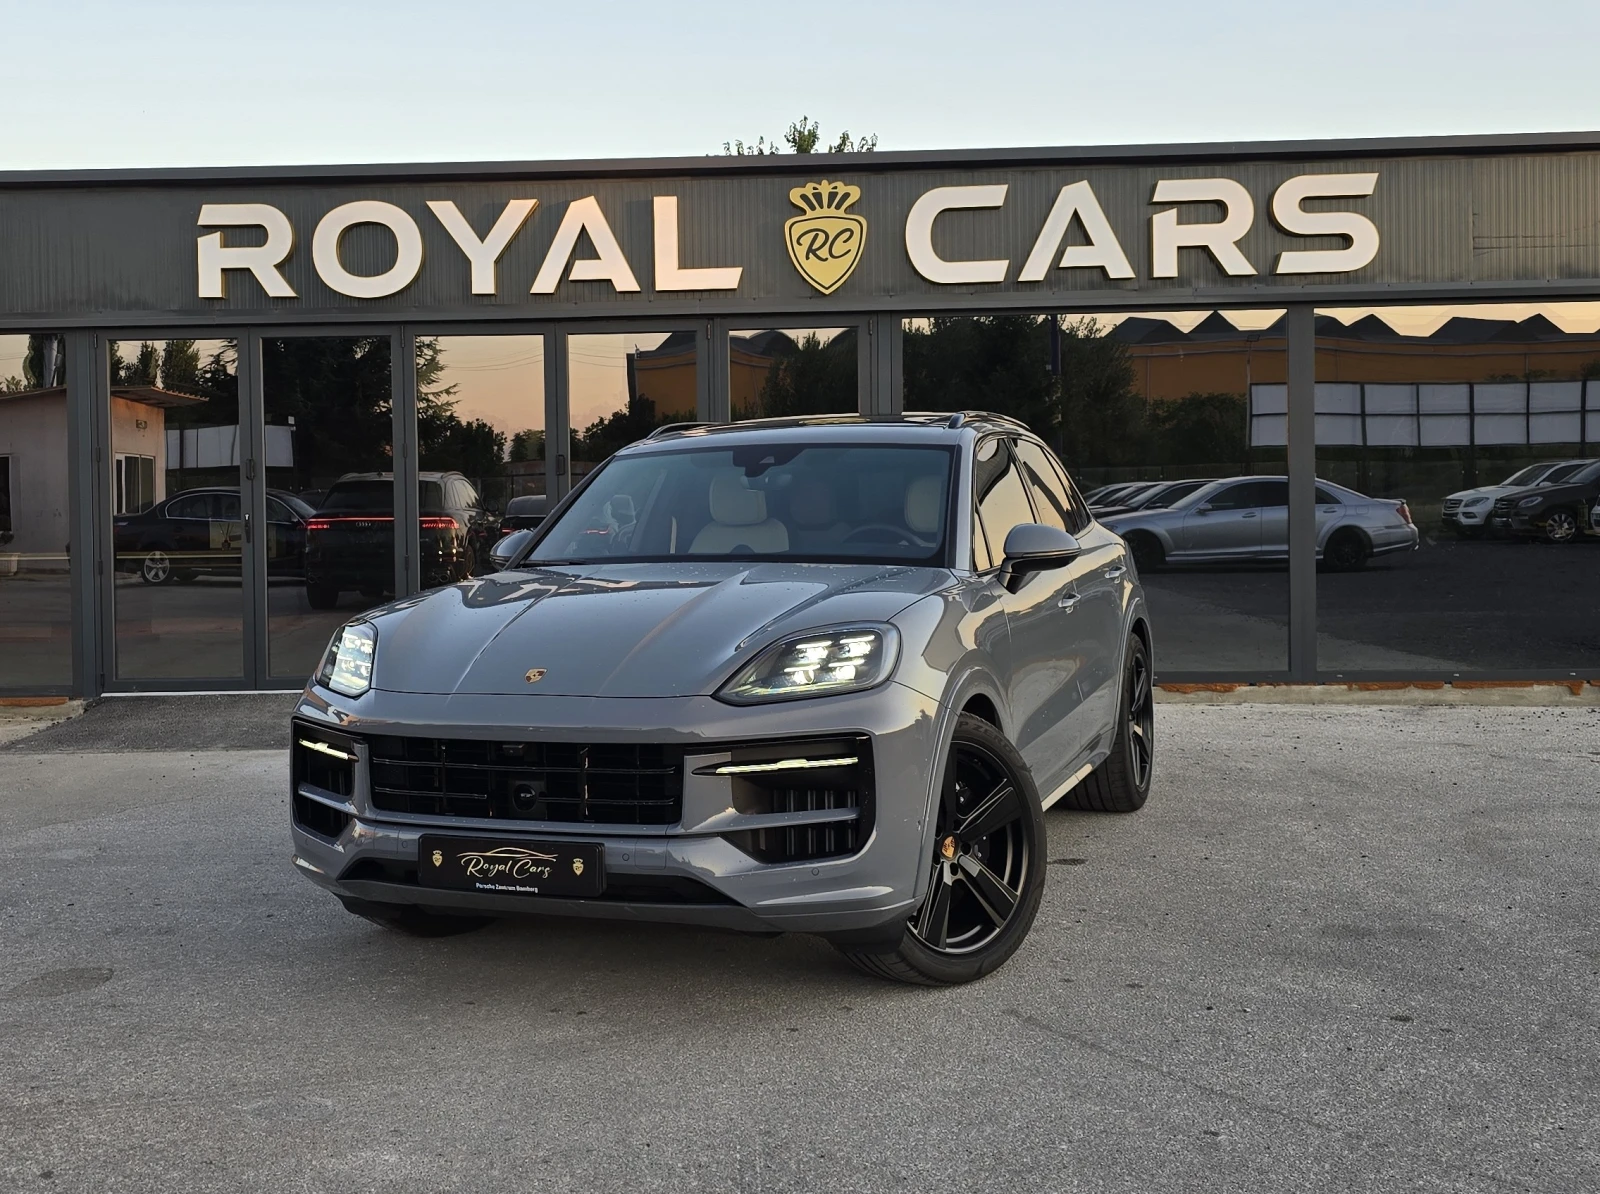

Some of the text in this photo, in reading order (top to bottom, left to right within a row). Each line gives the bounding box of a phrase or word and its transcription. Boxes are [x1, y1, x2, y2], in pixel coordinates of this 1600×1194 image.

[197, 172, 1381, 298] ROYAL CARS
[796, 227, 855, 262] RC
[460, 855, 553, 879] Royal Cars
